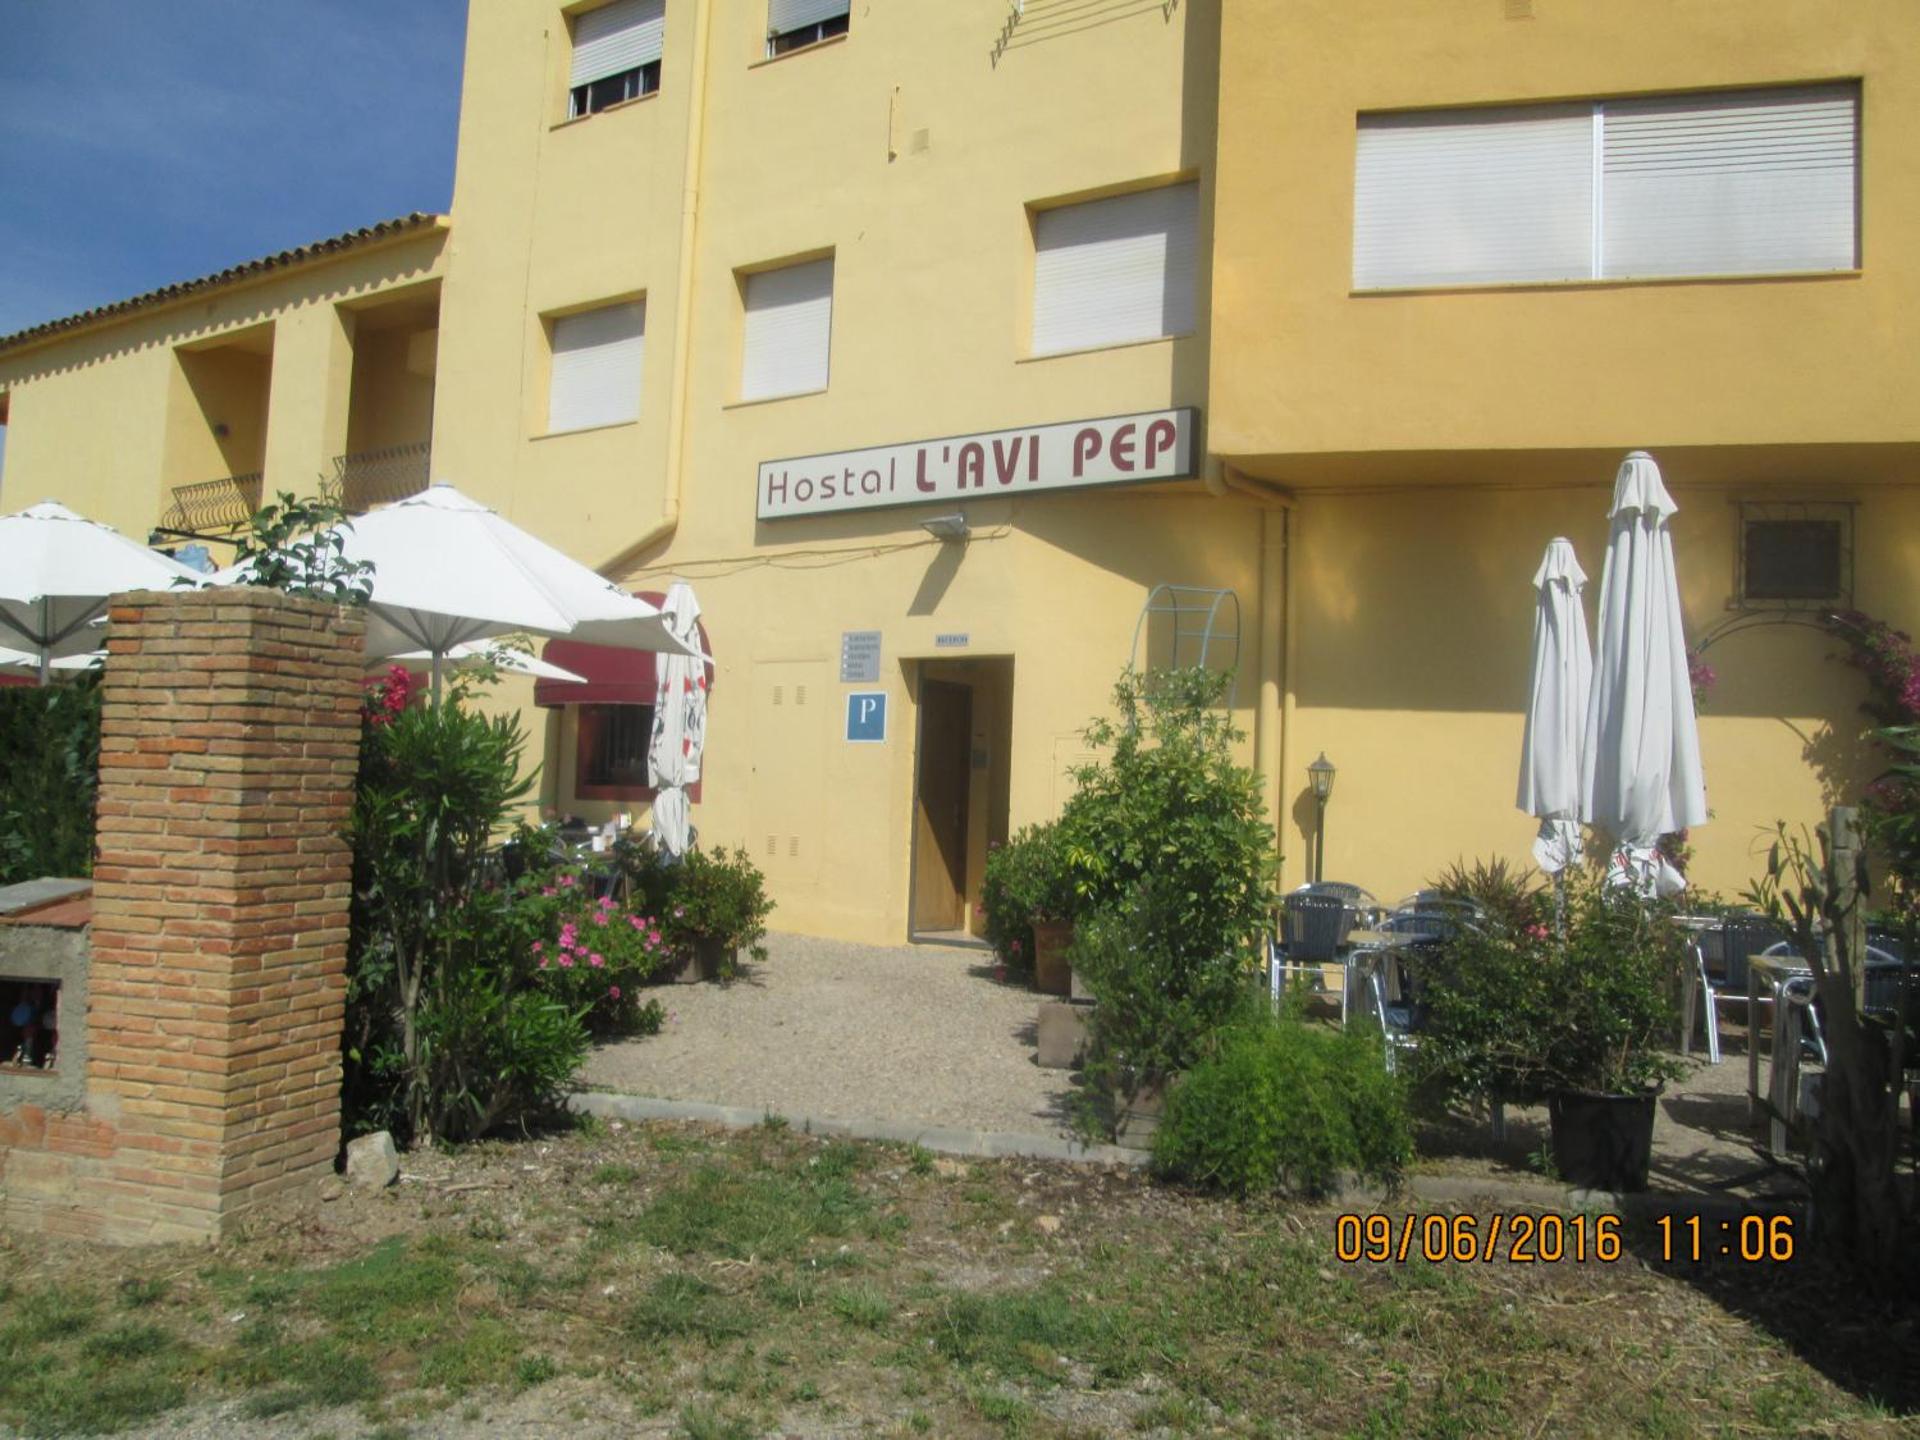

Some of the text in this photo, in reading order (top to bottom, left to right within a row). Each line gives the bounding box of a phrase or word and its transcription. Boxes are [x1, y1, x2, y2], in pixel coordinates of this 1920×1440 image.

[768, 418, 1177, 506] Hostal L'AVI PEP
[860, 698, 876, 724] P
